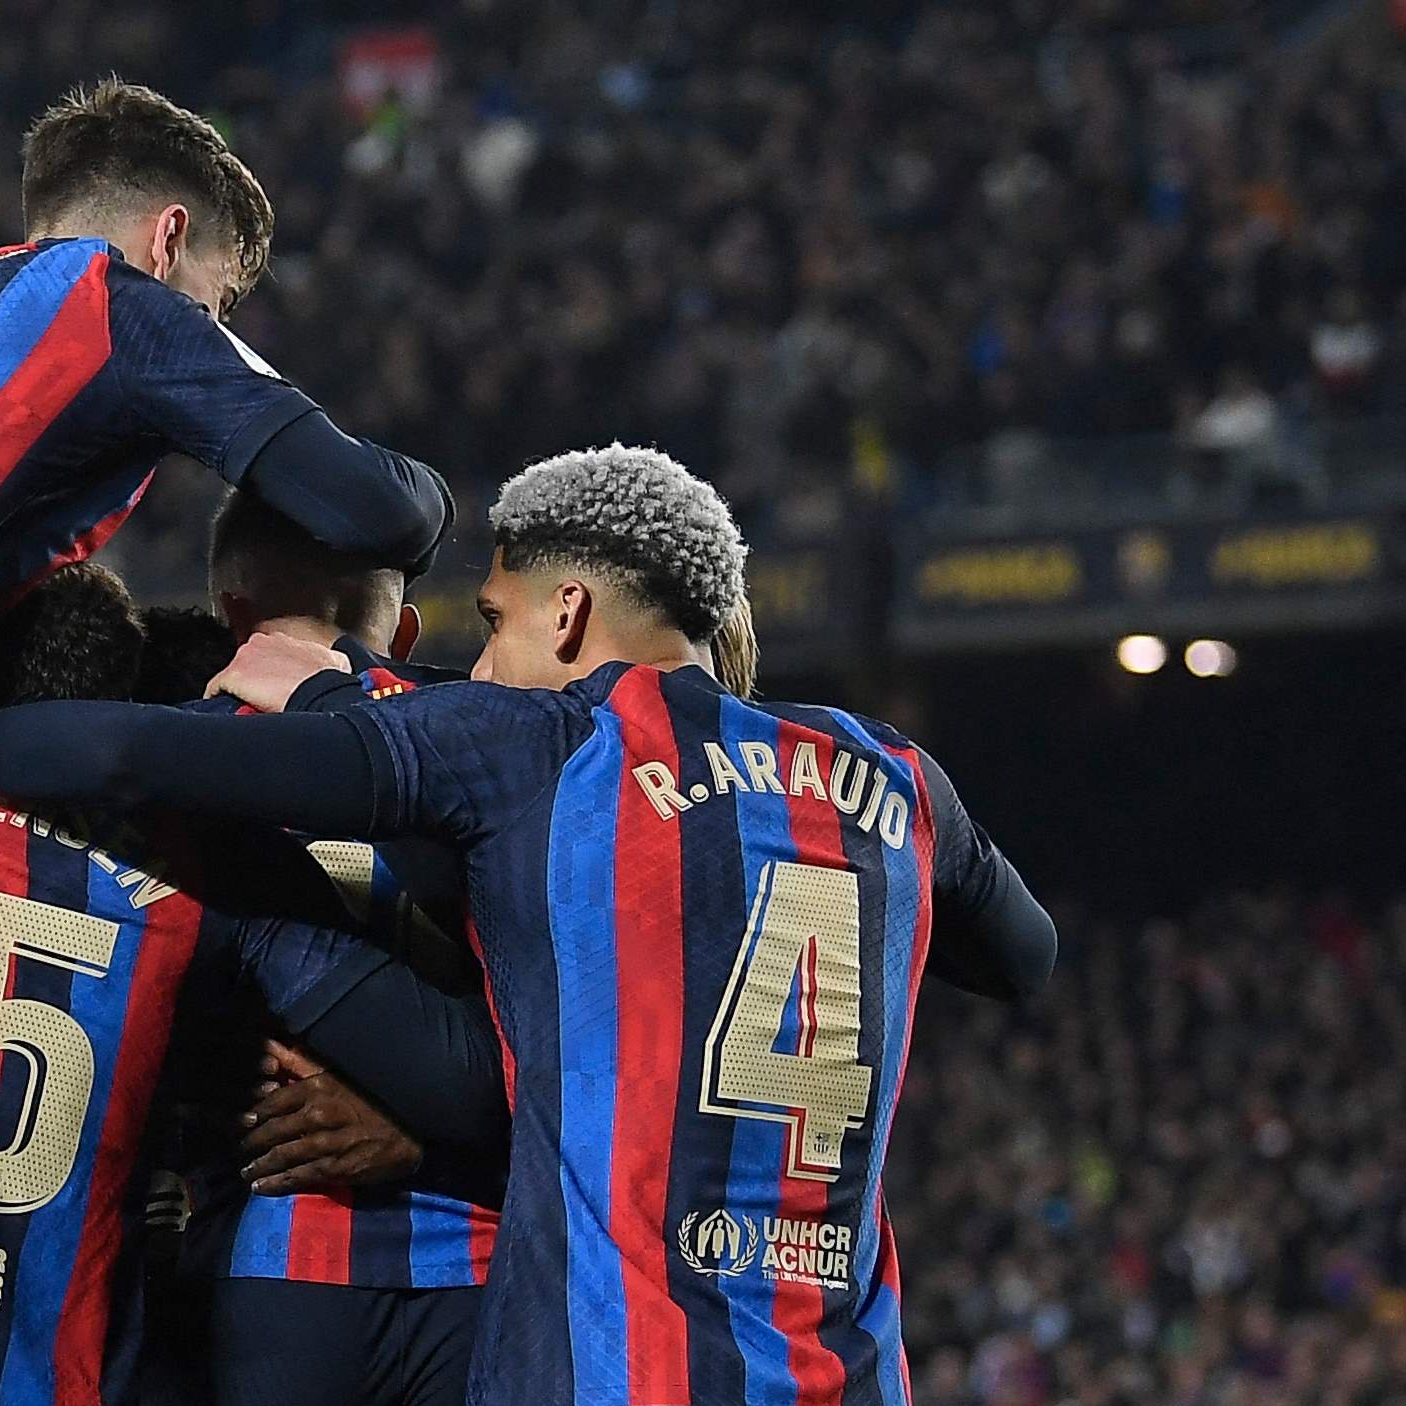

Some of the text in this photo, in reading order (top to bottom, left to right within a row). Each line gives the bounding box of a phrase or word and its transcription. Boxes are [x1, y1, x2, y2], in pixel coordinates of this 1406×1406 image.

[631, 740, 908, 850] R.ARAUJO
[699, 858, 872, 1182] 4
[761, 1243, 849, 1279] ACNUR
[763, 1216, 852, 1252] UNHCR
